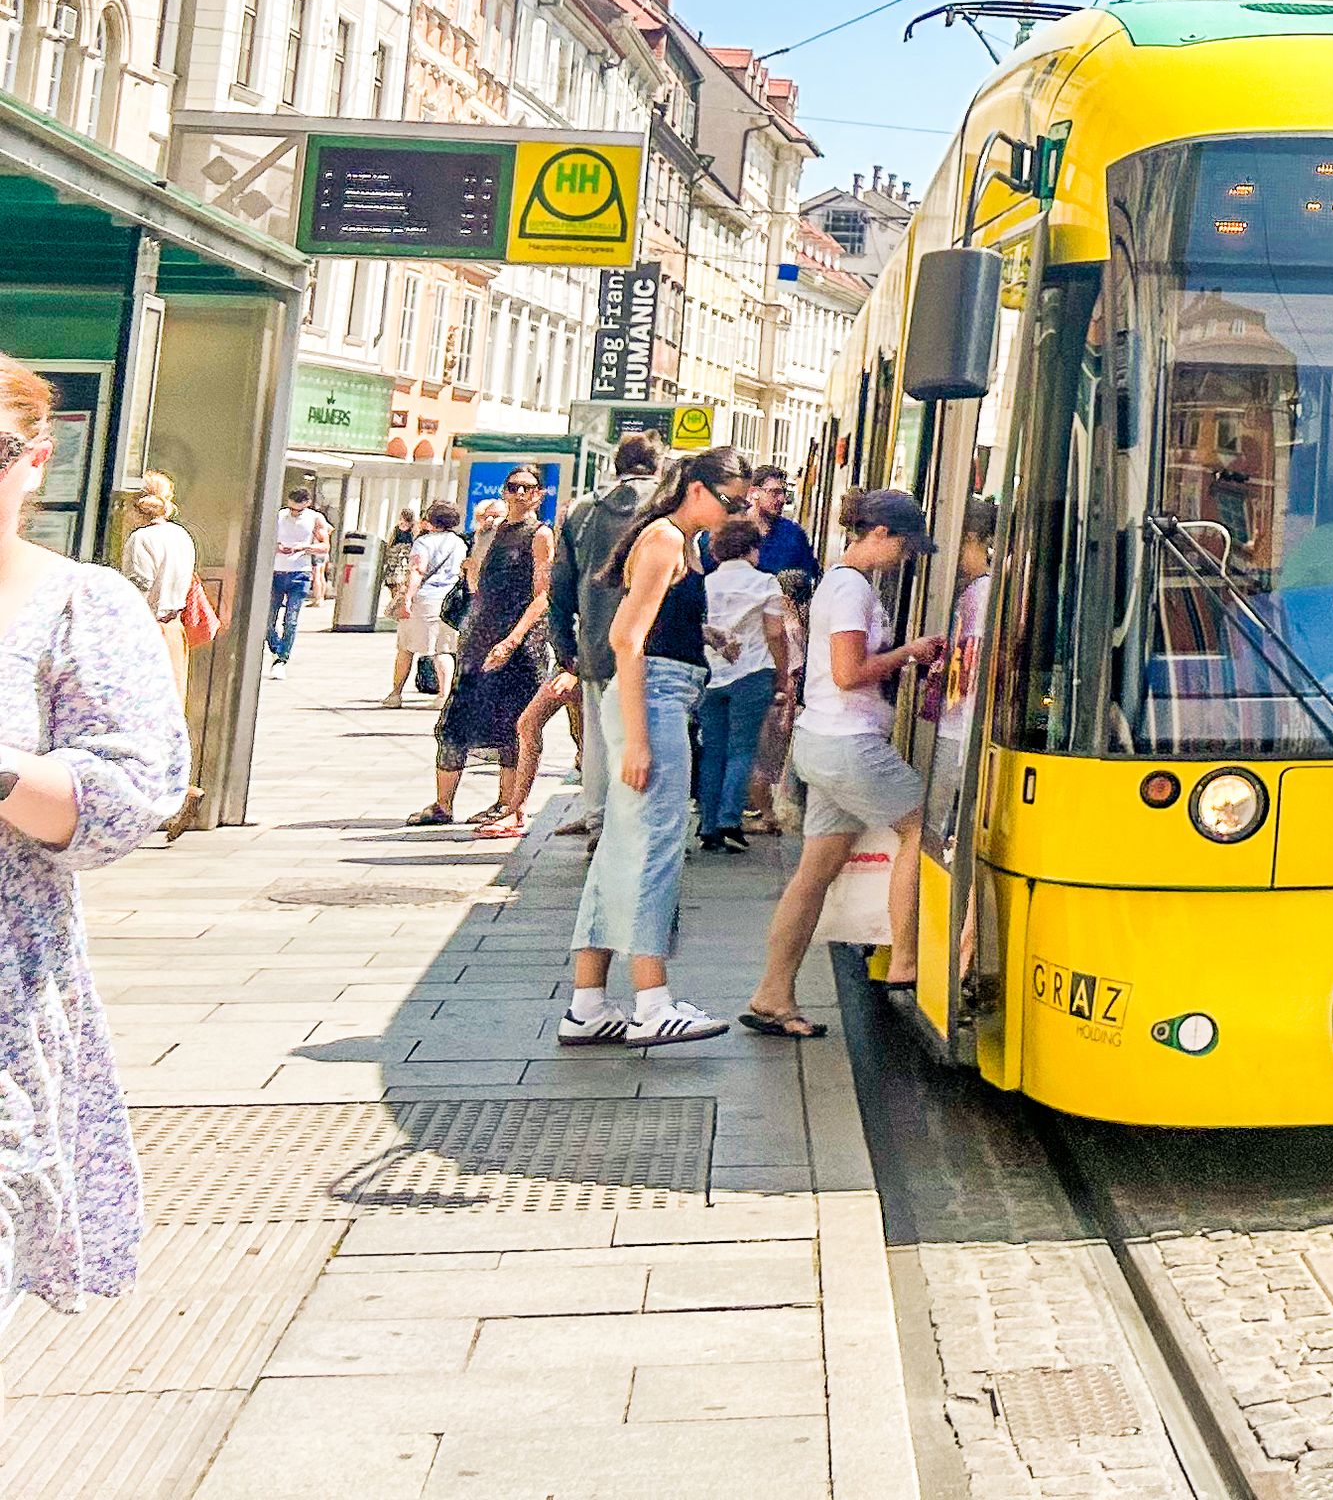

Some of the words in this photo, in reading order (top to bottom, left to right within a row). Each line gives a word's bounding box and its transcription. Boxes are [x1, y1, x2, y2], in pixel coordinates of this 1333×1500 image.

[555, 163, 601, 194] HH
[601, 269, 625, 329] Fran
[594, 336, 626, 392] Frag
[308, 406, 351, 427] PALMERS
[1033, 963, 1122, 1022] GRAZ
[1076, 1024, 1122, 1047] HOLDING
